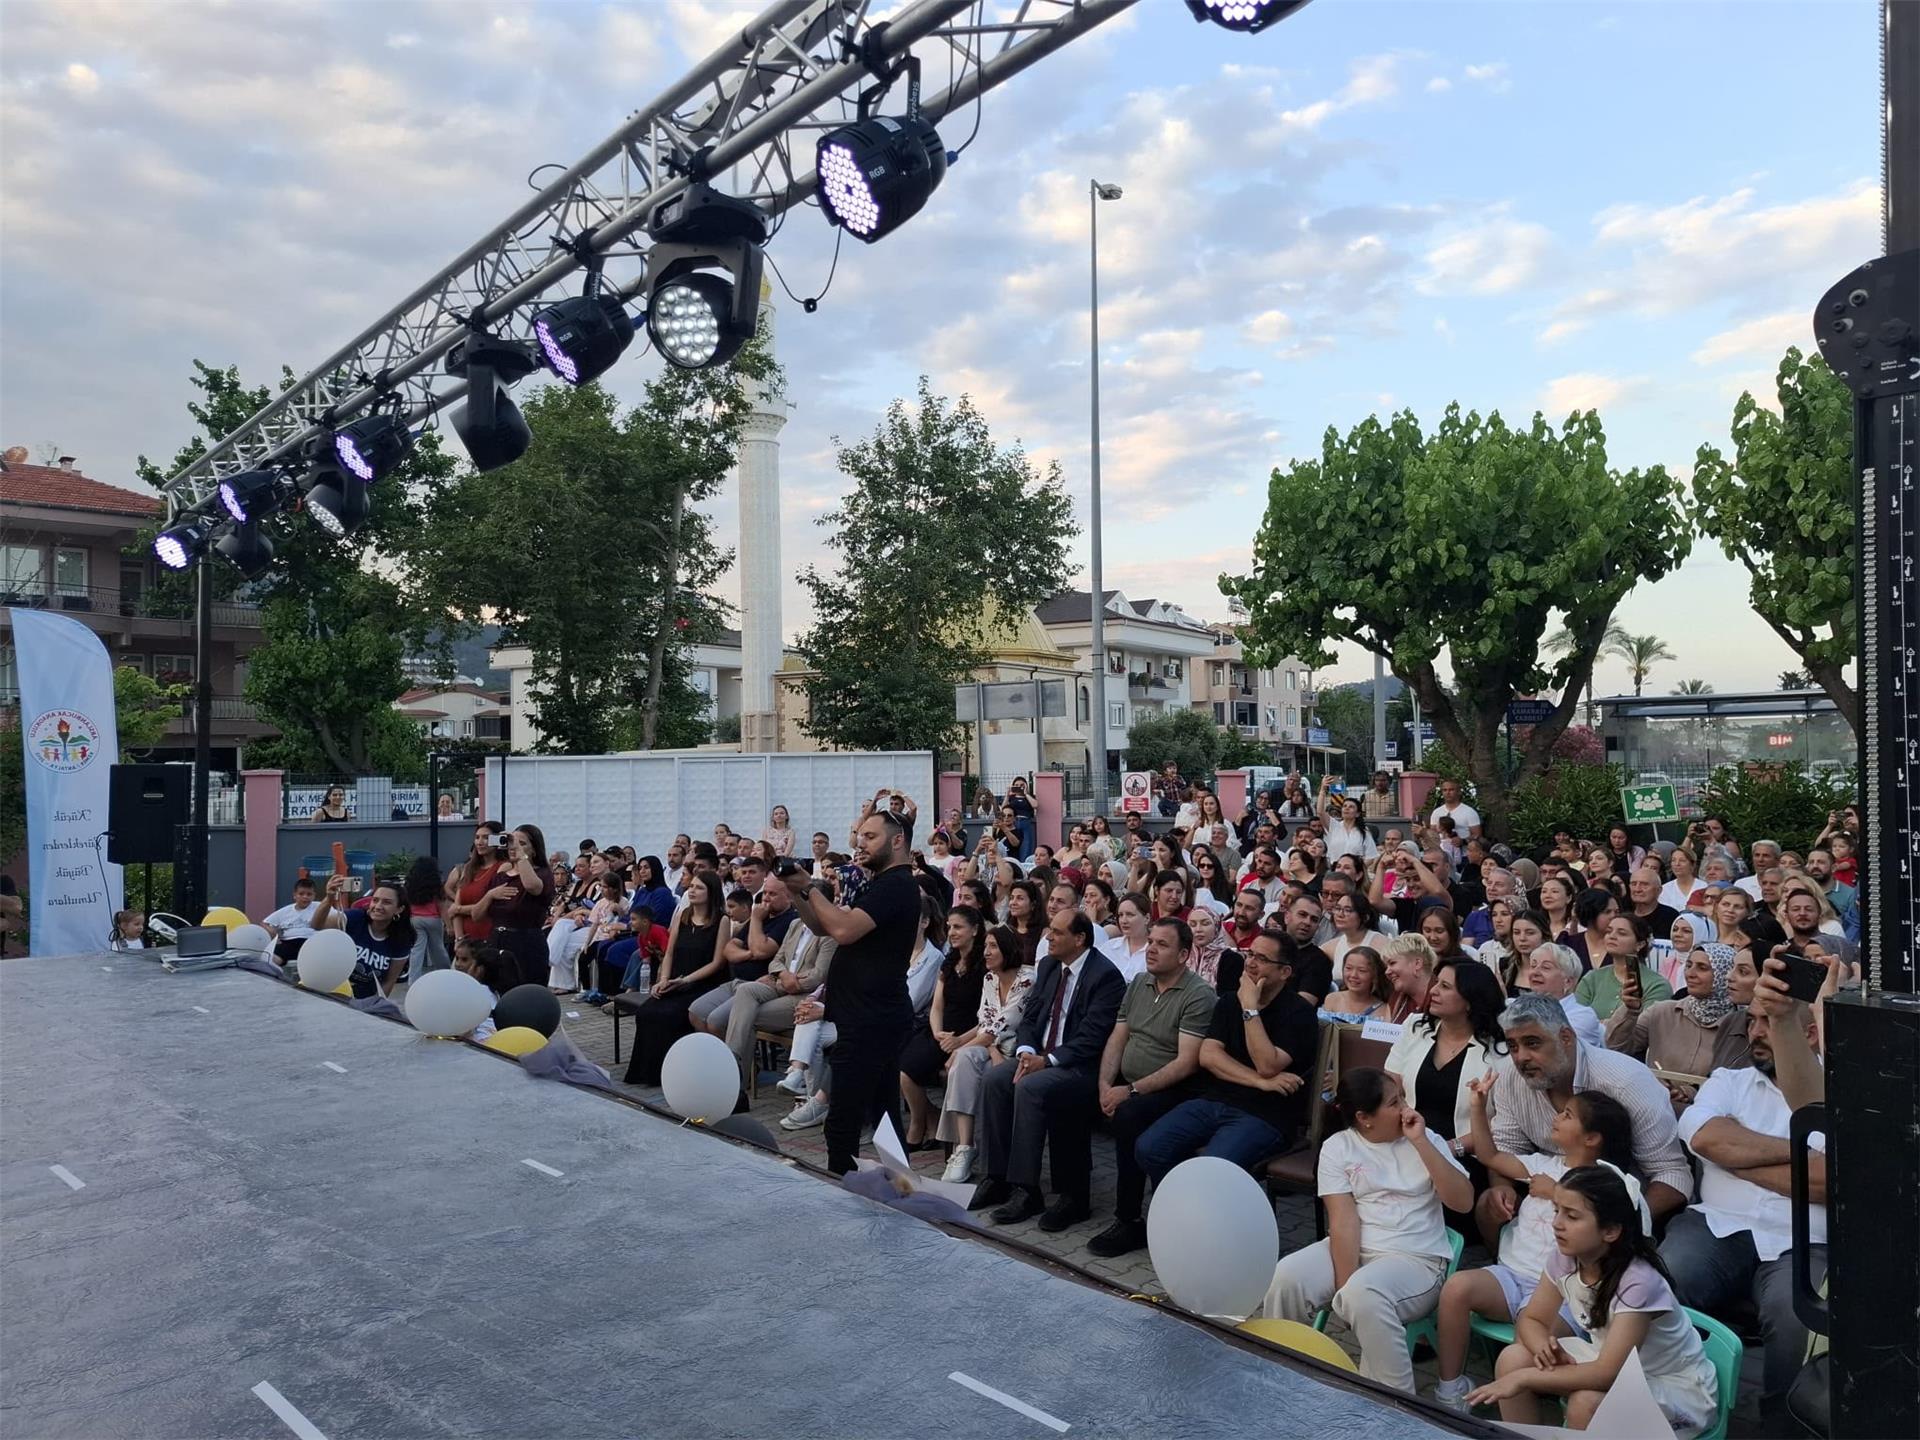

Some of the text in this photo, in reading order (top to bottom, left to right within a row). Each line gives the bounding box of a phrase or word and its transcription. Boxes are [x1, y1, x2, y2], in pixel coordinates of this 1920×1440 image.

[909, 80, 919, 123] StageArt
[868, 166, 886, 180] RGB
[355, 944, 391, 971] PARIS
[1368, 1027, 1400, 1036] PROTOKO
